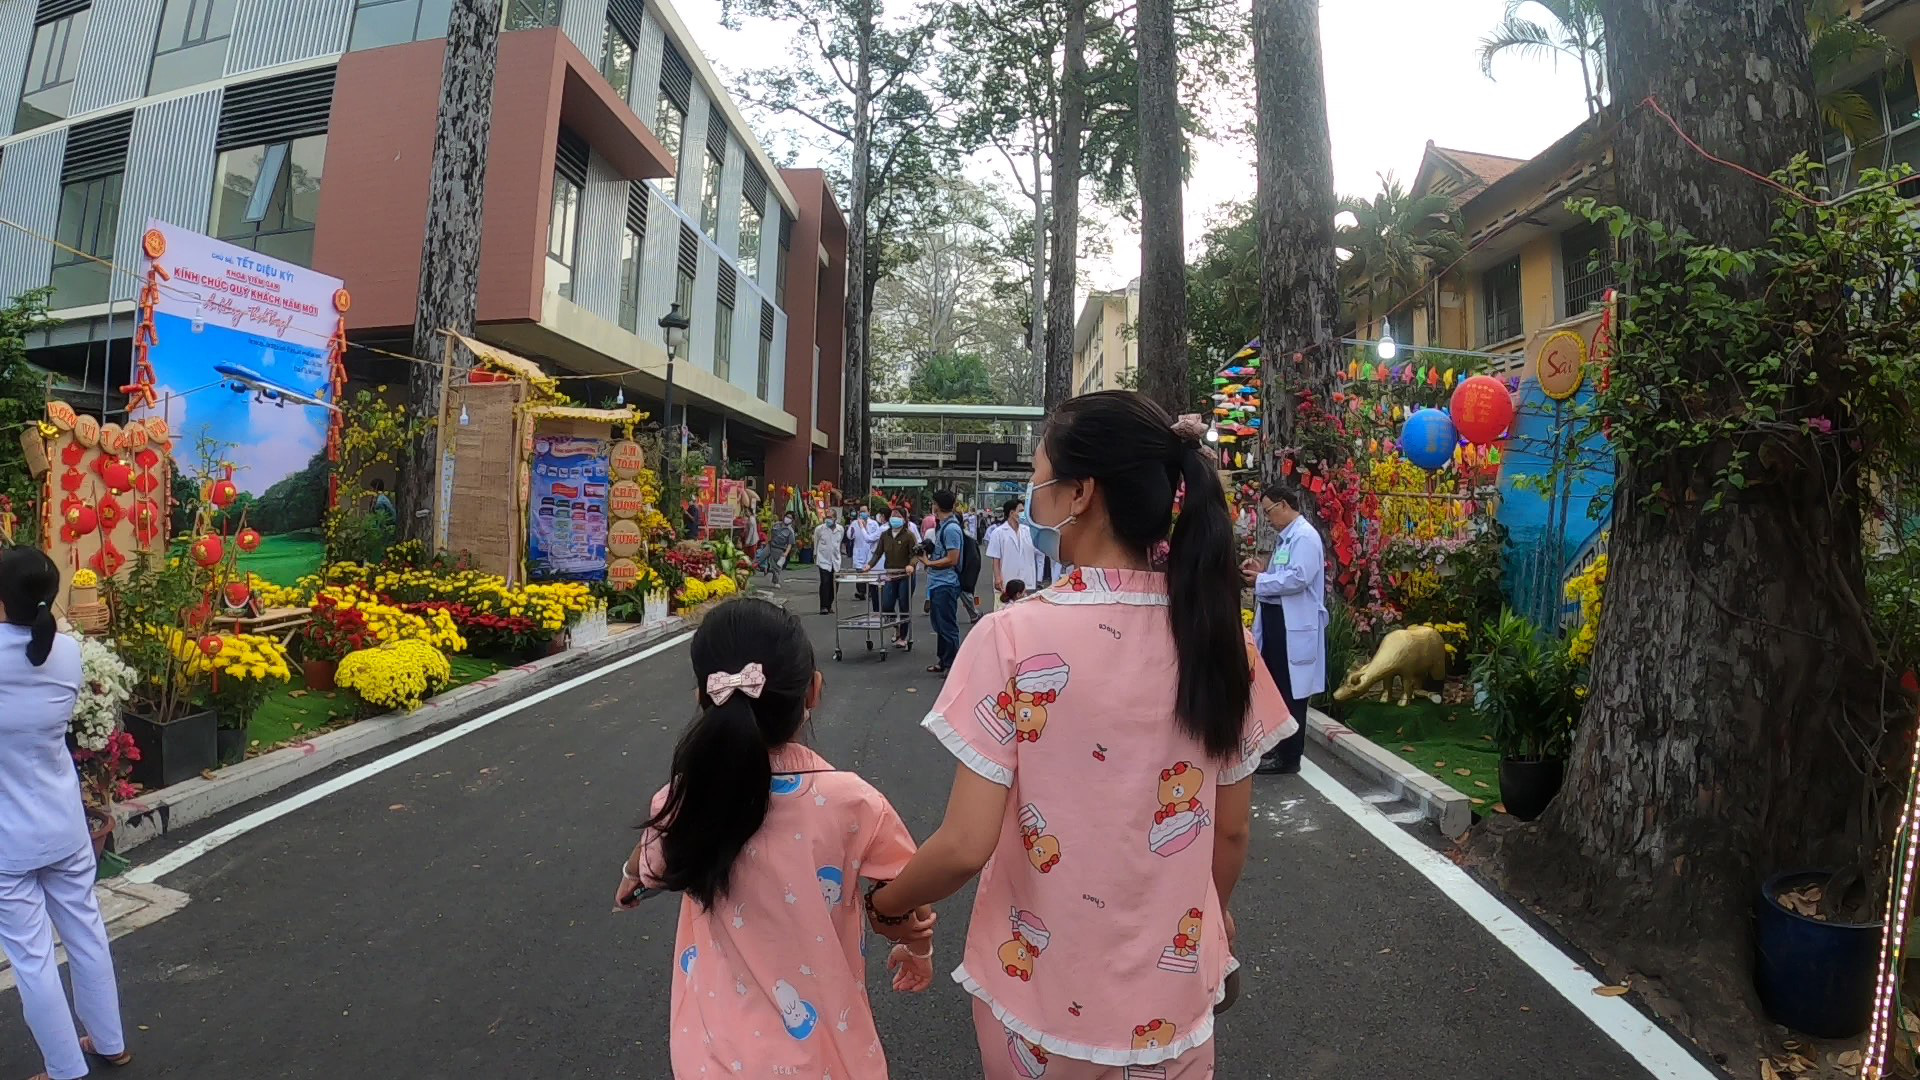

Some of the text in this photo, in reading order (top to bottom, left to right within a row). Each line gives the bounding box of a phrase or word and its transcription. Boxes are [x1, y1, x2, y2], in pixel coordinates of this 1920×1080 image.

[236, 256, 254, 270] TẾT
[256, 263, 277, 277] DIỆU
[200, 274, 227, 291] CHÚC
[251, 288, 281, 305] KHÁCH
